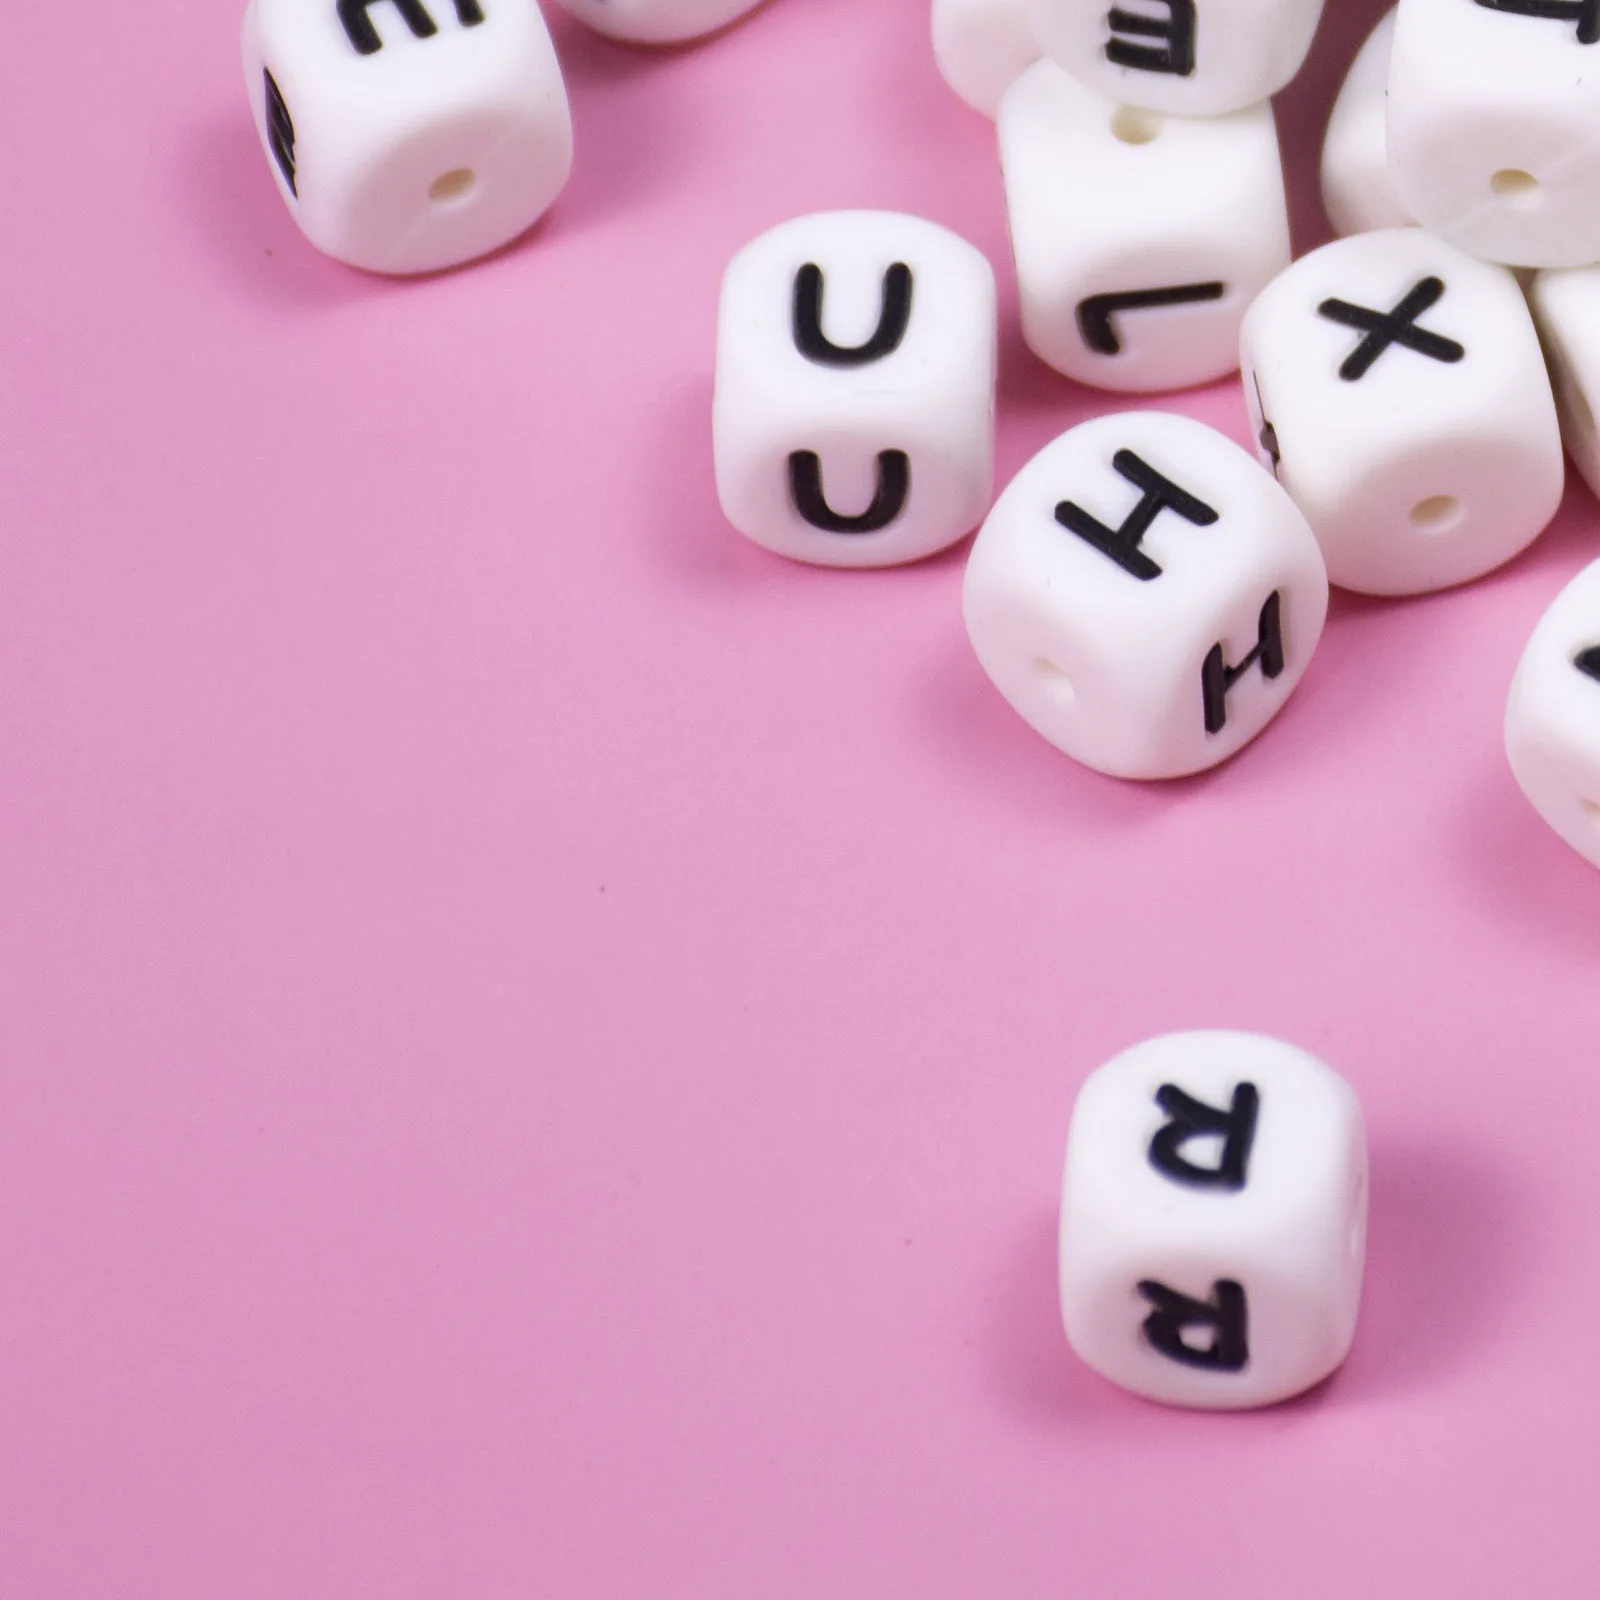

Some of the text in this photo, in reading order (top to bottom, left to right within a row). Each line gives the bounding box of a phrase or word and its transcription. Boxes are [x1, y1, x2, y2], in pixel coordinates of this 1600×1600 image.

[792, 261, 913, 368] U
[1076, 280, 1224, 356] L
[1318, 275, 1466, 382] X
[787, 447, 910, 535] U
[1053, 447, 1220, 582] H
[1200, 587, 1285, 736] H
[1149, 1080, 1260, 1196] R
[1136, 1277, 1250, 1374] R
